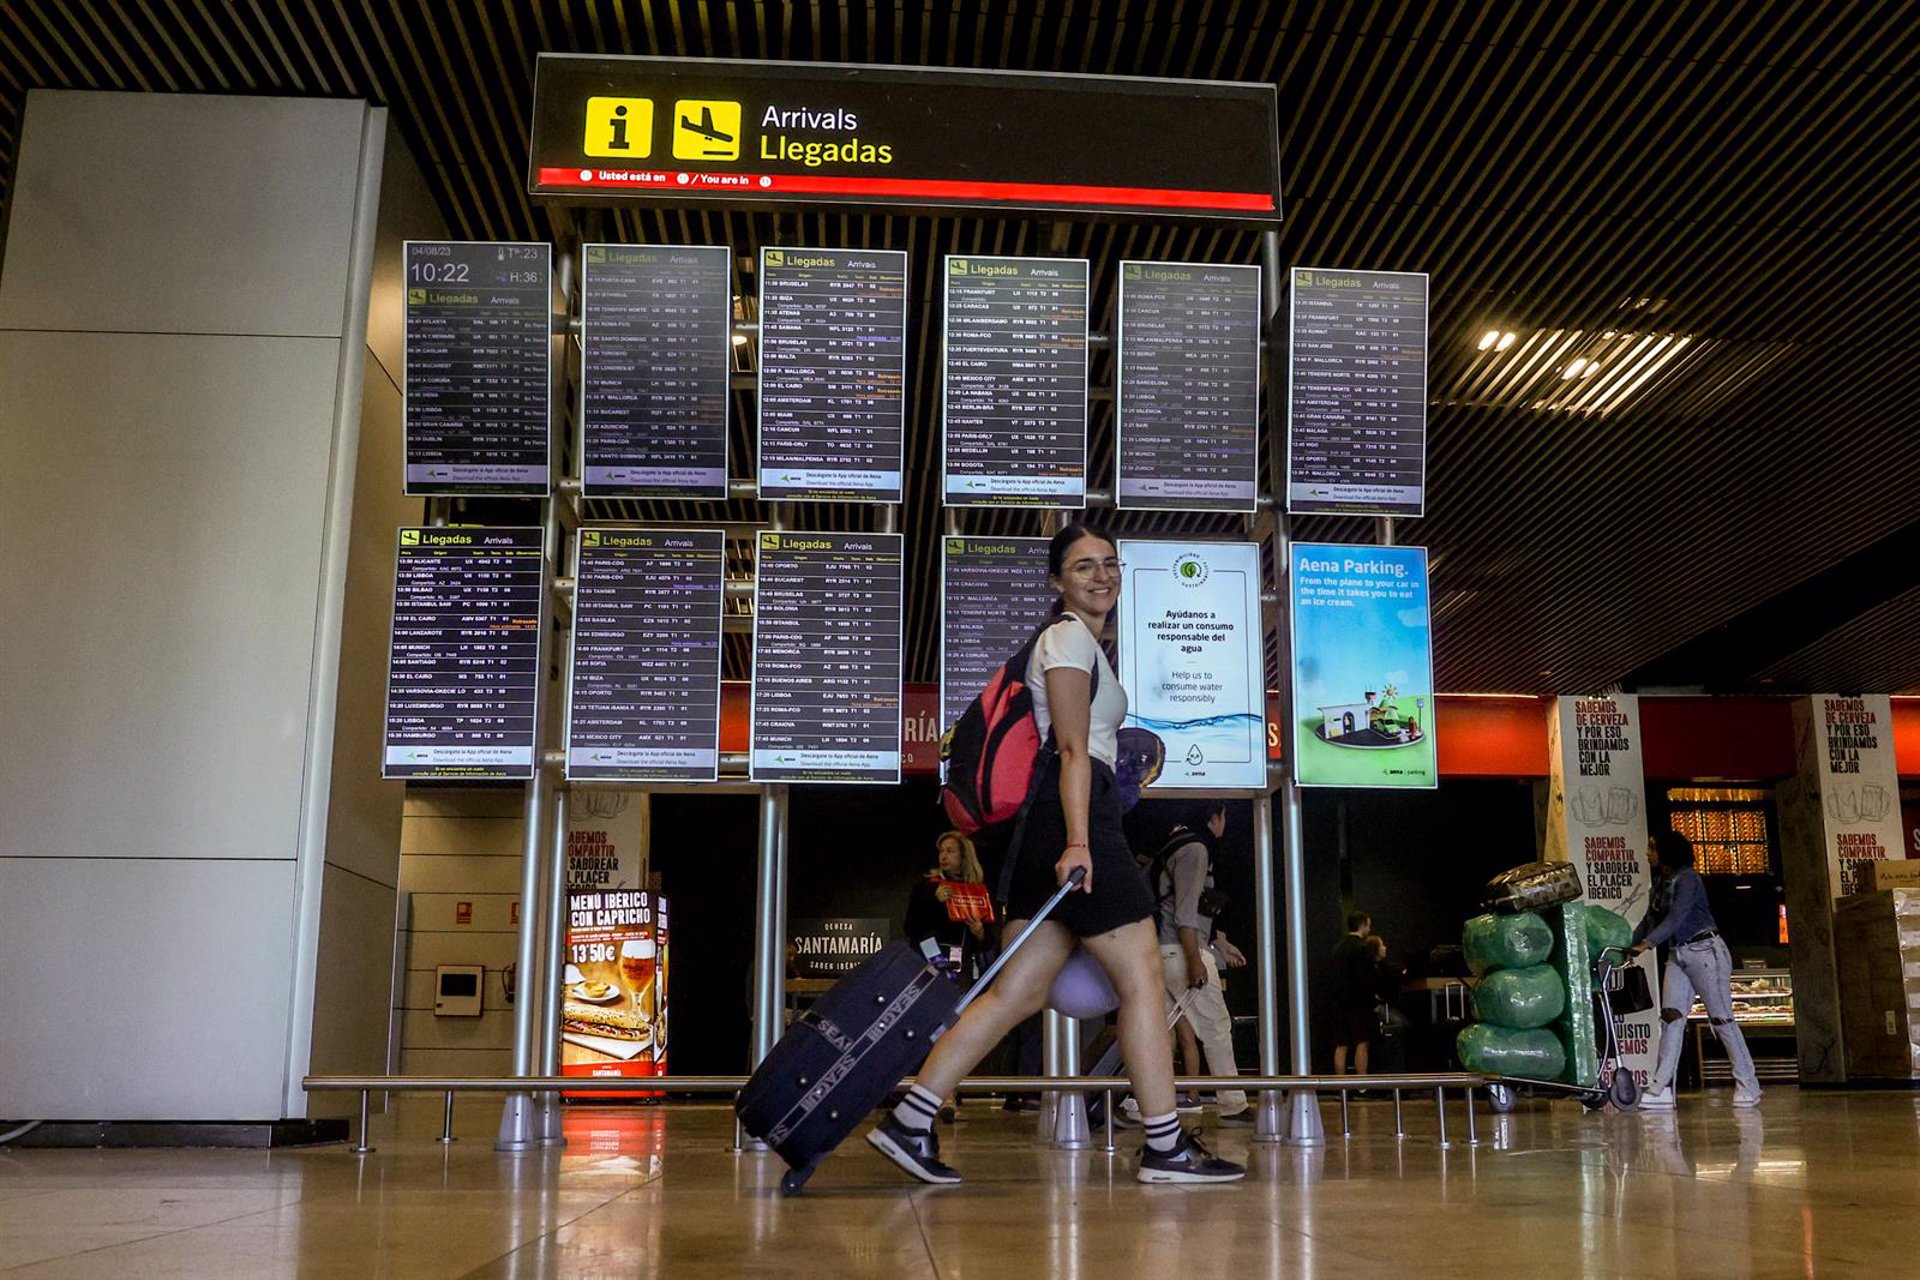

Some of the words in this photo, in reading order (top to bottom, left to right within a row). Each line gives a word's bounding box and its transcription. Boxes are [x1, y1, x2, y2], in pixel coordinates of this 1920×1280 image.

[761, 105, 858, 132] Arrivals
[760, 134, 893, 167] Llegadas
[599, 170, 628, 181] Usted
[630, 171, 651, 182] está
[653, 174, 666, 182] en
[700, 174, 720, 184] You
[721, 176, 738, 184] are
[740, 175, 749, 185] in
[412, 246, 451, 257] 04/08/23
[787, 255, 836, 268] Llegadas
[847, 260, 876, 269] Arrivals
[411, 263, 469, 282] 10:22
[970, 263, 1018, 277] Llegadas
[1030, 268, 1059, 277] Arrivals
[1145, 269, 1192, 282] Llegadas
[1316, 277, 1362, 289] Llegadas
[429, 292, 479, 304] Llegadas
[422, 534, 472, 545] Llegadas
[484, 537, 513, 545] Arrivals
[603, 535, 652, 547] Llegadas
[664, 538, 694, 547] Arrivals
[783, 538, 832, 550] Llegadas
[844, 542, 873, 550] Arrivals
[968, 543, 1016, 554] Llegadas
[1028, 546, 1050, 555] Arriva
[1299, 557, 1340, 573] Aena
[1344, 558, 1409, 578] Parking.
[1300, 577, 1323, 585] From
[1323, 577, 1338, 586] the
[1340, 578, 1363, 587] plane
[1365, 579, 1374, 587] to
[1376, 580, 1394, 589] your
[1300, 587, 1315, 596] the
[1317, 588, 1337, 596] time
[1338, 588, 1345, 596] it
[1346, 588, 1369, 597] takes
[1371, 590, 1387, 599] you
[1388, 590, 1398, 598] to
[1313, 598, 1326, 606] ice
[1327, 599, 1355, 607] cream.
[1166, 609, 1208, 620] Ayúdanos
[1148, 621, 1180, 630] realizar
[1157, 633, 1210, 642] responsable
[1211, 633, 1226, 642] del
[1181, 645, 1203, 654] agua
[1171, 671, 1191, 680] Help
[1204, 672, 1213, 680] to
[1162, 683, 1198, 691] consume
[1169, 694, 1216, 704] responsibly
[1824, 699, 1865, 711] SABEMOS
[1575, 701, 1617, 713] SABEMOS
[1576, 713, 1588, 726] DE
[1590, 713, 1629, 726] CERVEZA
[1825, 711, 1837, 724] DE
[1838, 711, 1877, 724] CERVEZA
[1577, 726, 1583, 738] Y
[1585, 726, 1602, 739] POR
[1605, 726, 1621, 739] ESO
[1826, 724, 1832, 736] Y
[1834, 724, 1851, 736] POR
[1854, 724, 1870, 736] ESO
[1578, 738, 1629, 751] BRINDAMOS
[1828, 736, 1878, 749] BRINDAMOS
[1579, 751, 1597, 764] CON
[1599, 751, 1610, 764] LA
[1829, 748, 1846, 761] CON
[1848, 749, 1860, 761] LA
[1580, 763, 1610, 776] MEJOR
[1830, 761, 1860, 774] MEJOR
[568, 831, 607, 844] ABEMOS
[1585, 836, 1626, 849] SABEMOS
[1836, 833, 1877, 846] SABEMOS
[568, 845, 615, 857] OMPARTIR
[1586, 849, 1635, 862] COMPARTIR
[1837, 846, 1886, 858] COMPARTIR
[570, 857, 619, 871] SABOREAR
[1586, 861, 1592, 874] Y
[1594, 862, 1640, 875] SABOREAR
[1838, 859, 1845, 870] Y
[575, 871, 610, 884] PLACER
[1587, 874, 1598, 887] EL
[1600, 874, 1632, 887] PLACER
[1588, 886, 1622, 900] IBÉRICO
[570, 892, 602, 911] MENÚ
[604, 891, 648, 909] IBÉRICO
[571, 911, 594, 927] CON
[596, 908, 651, 926] CAPRICHO
[794, 931, 883, 954] SANTAMARÍA
[1613, 1023, 1651, 1039] UISITO
[1618, 1039, 1648, 1055] EMOS
